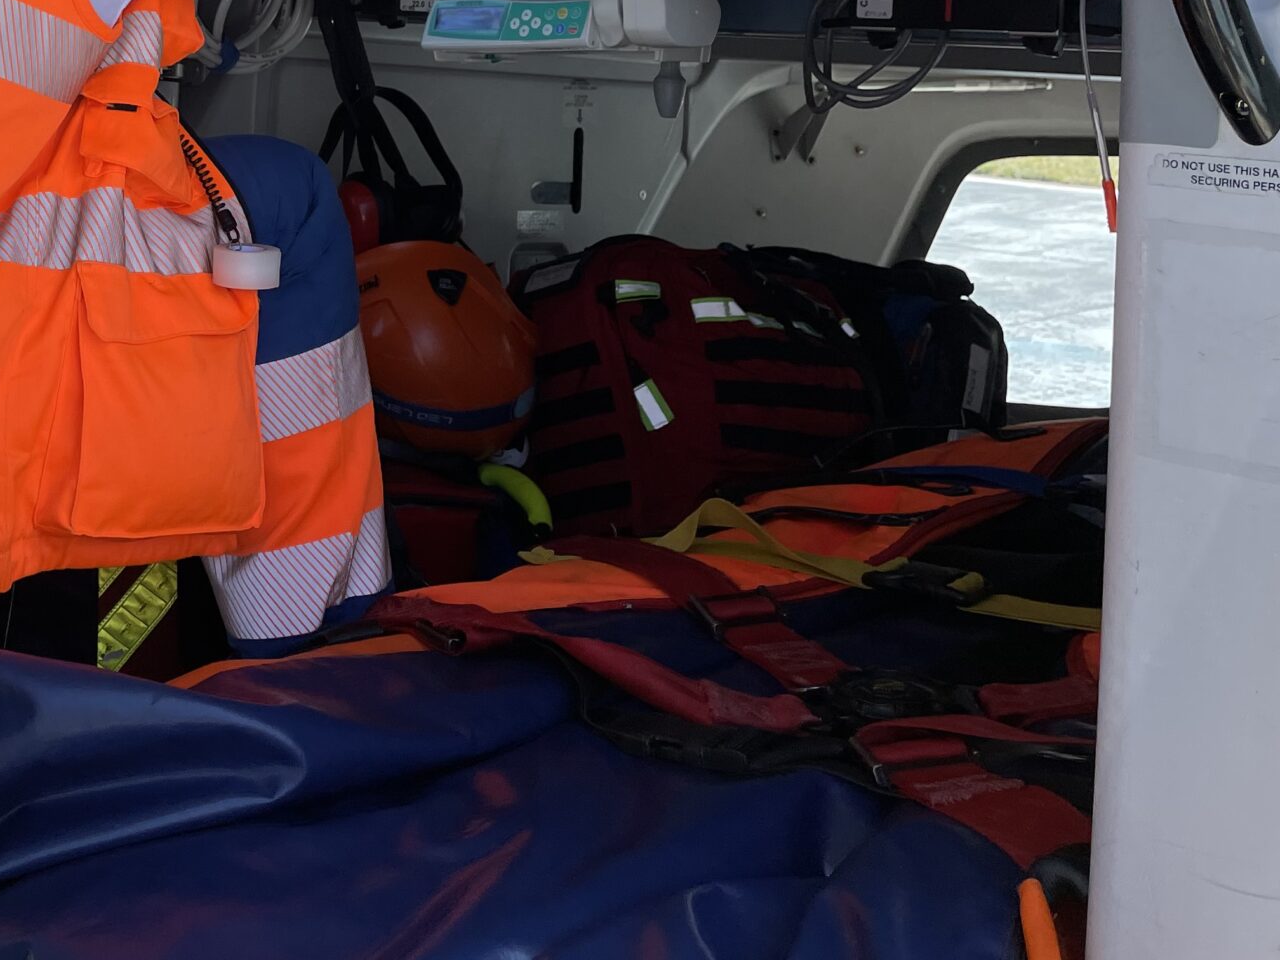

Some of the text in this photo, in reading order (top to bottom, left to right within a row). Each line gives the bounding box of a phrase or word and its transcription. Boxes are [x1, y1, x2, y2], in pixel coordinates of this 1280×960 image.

[1162, 159, 1178, 169] DO
[1181, 160, 1206, 171] NOT
[1208, 163, 1231, 174] USE
[1233, 165, 1260, 177] THIS
[1190, 174, 1249, 190] SECURING
